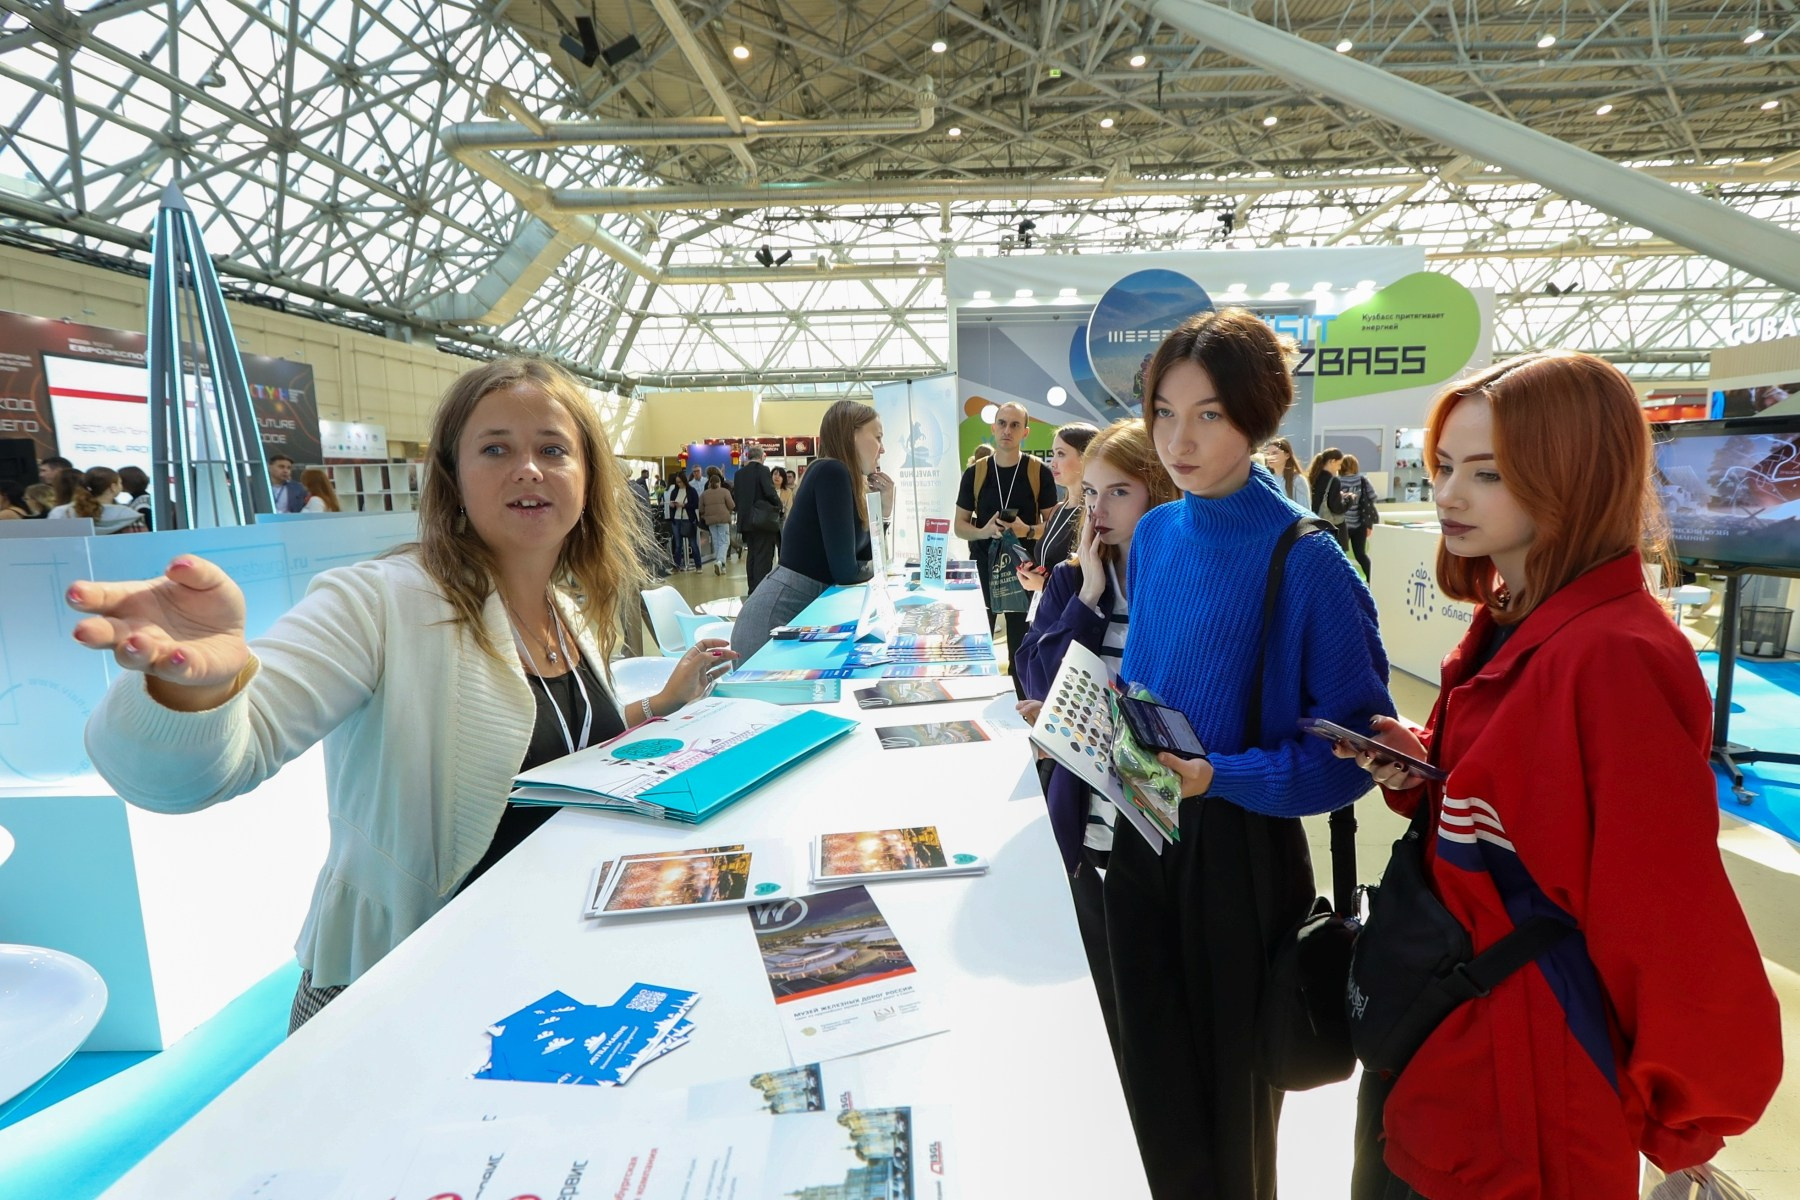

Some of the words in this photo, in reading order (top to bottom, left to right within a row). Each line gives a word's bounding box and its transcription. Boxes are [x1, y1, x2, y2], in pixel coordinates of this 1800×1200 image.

[1362, 313, 1393, 321] Кузбасс
[1395, 312, 1445, 321] притягивает
[793, 1008, 819, 1018] МУЗЕЙ
[820, 998, 860, 1012] ЖЕЛЕЗНЫХ
[861, 993, 884, 1003] ДОРОГ
[885, 986, 913, 996] РОССИИ
[589, 1046, 610, 1066] ASTRA
[606, 1025, 629, 1047] MARINE
